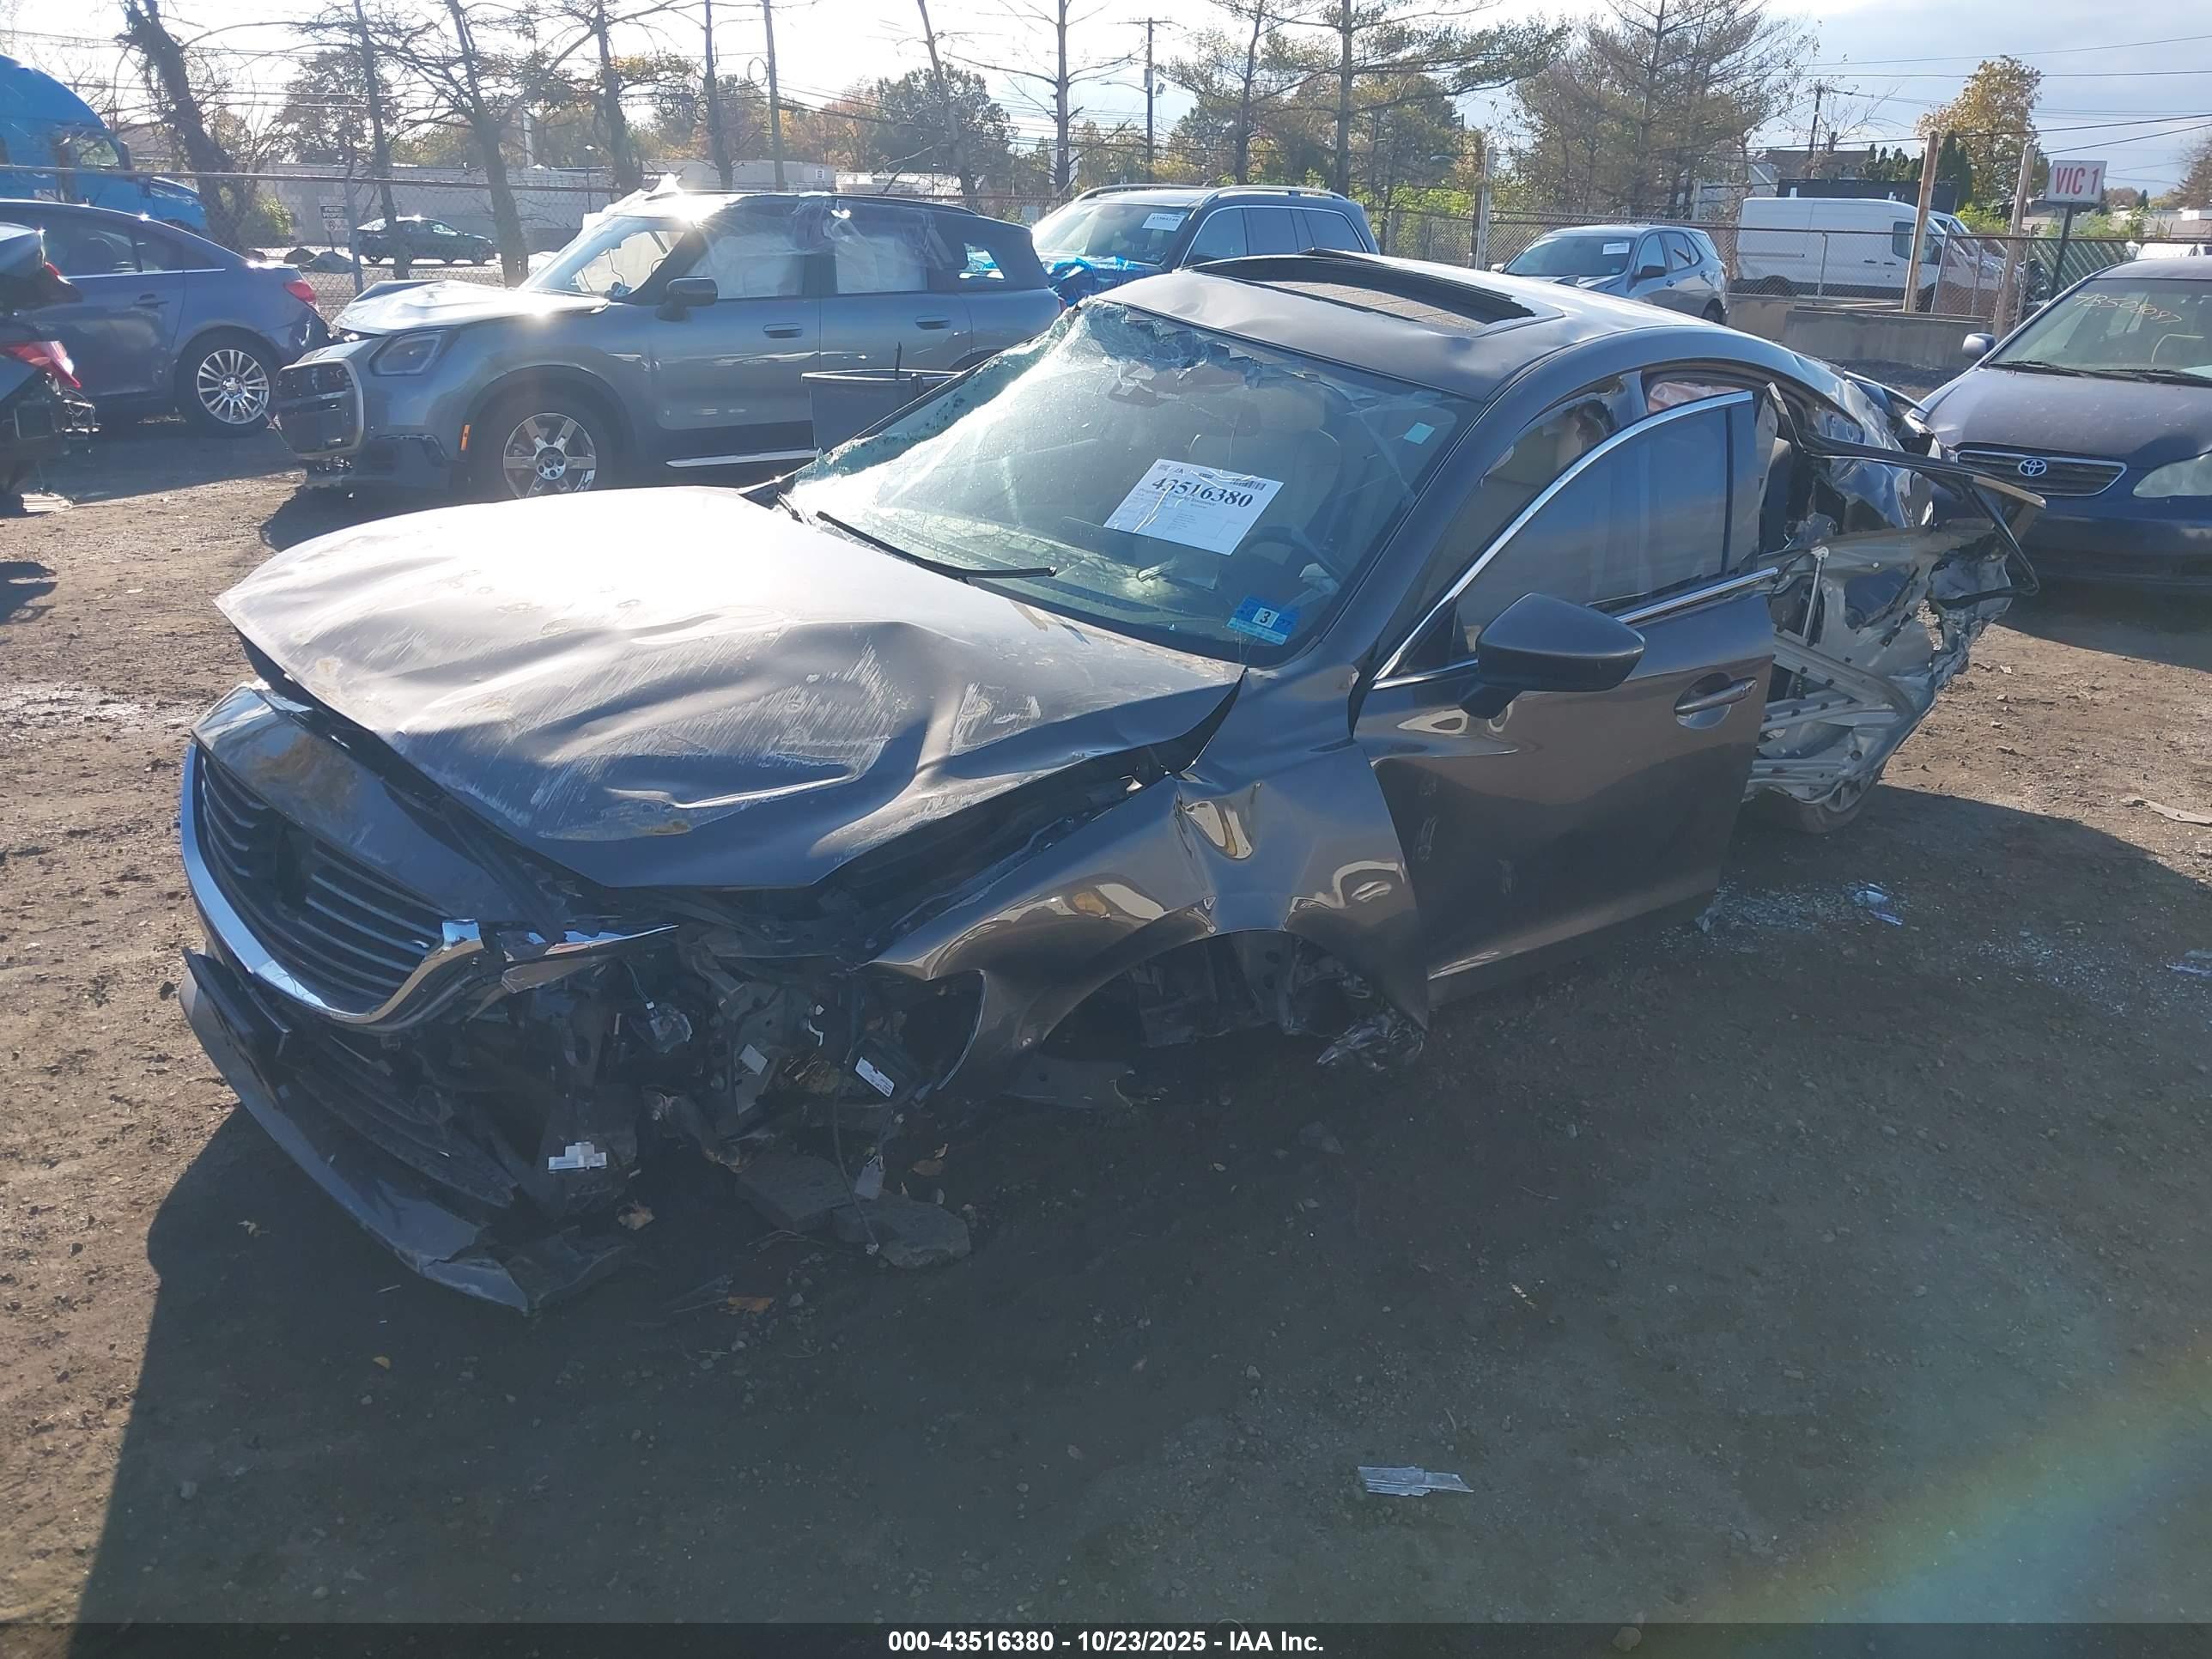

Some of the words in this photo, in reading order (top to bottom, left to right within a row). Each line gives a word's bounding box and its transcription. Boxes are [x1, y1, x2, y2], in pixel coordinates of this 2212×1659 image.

[2055, 167, 2086, 195] VIC
[2090, 167, 2100, 195] 1
[1152, 477, 1254, 508] 43516380
[1259, 611, 1272, 623] 3
